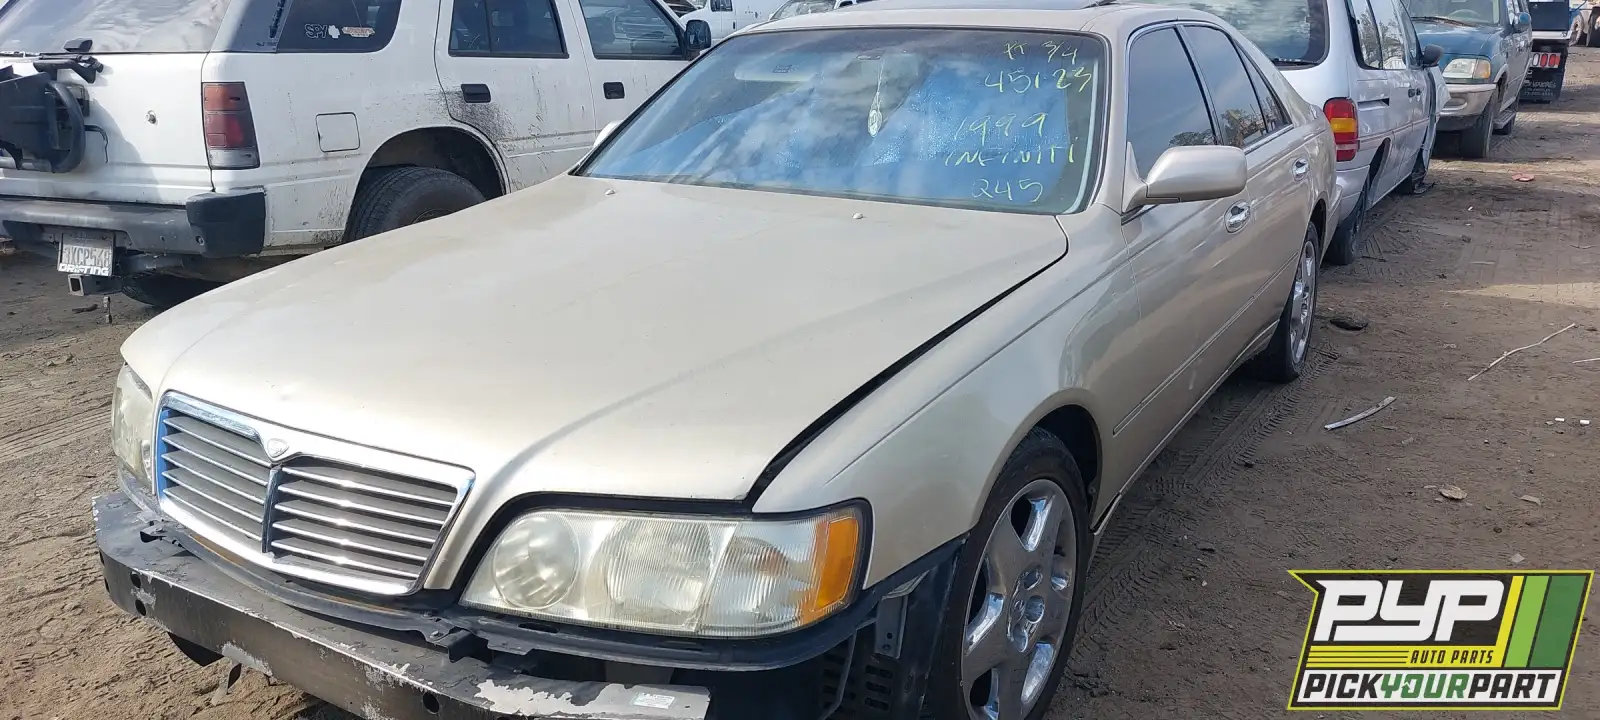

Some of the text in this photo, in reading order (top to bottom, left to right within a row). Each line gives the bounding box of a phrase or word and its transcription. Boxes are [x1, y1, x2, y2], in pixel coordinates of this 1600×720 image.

[304, 23, 328, 39] SPY
[954, 112, 1048, 146] 1999
[58, 262, 110, 277] DRIFTING
